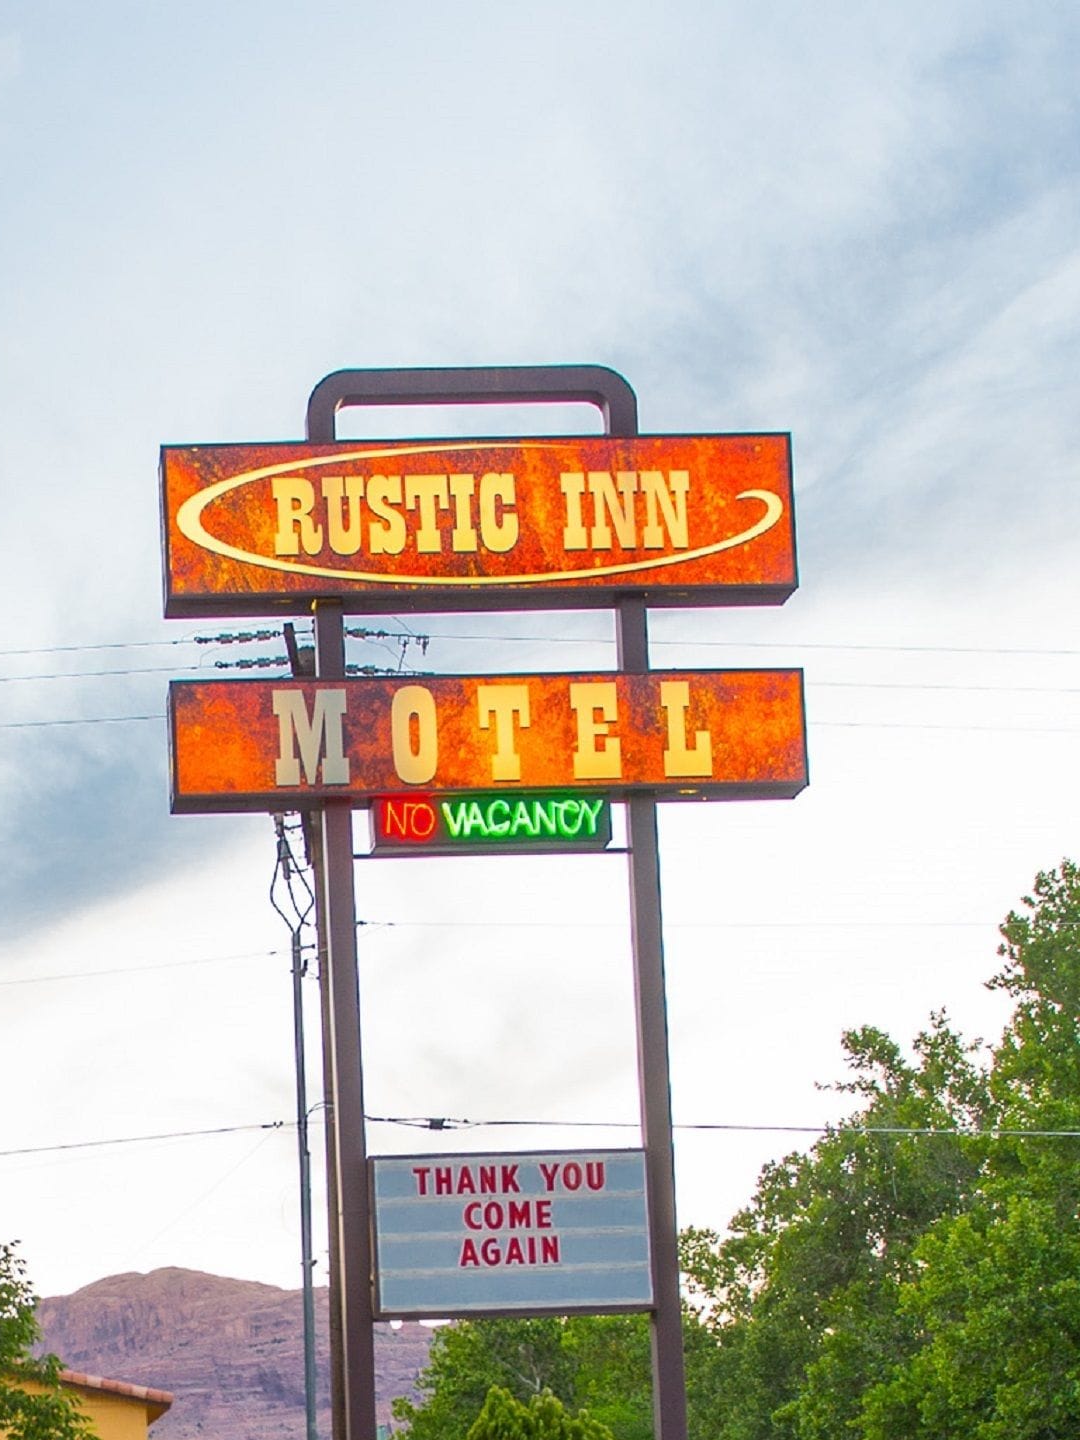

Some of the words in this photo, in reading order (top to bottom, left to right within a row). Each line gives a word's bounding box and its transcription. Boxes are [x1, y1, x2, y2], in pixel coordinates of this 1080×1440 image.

[272, 473, 520, 557] RUSTIC
[560, 470, 690, 550] INN
[272, 680, 713, 787] MOTEL
[385, 801, 436, 837] NO
[441, 799, 604, 838] VACANCY
[412, 1164, 520, 1196] THANK
[539, 1161, 606, 1192] YOU
[463, 1199, 553, 1231] COME
[460, 1235, 561, 1267] AGAIN
